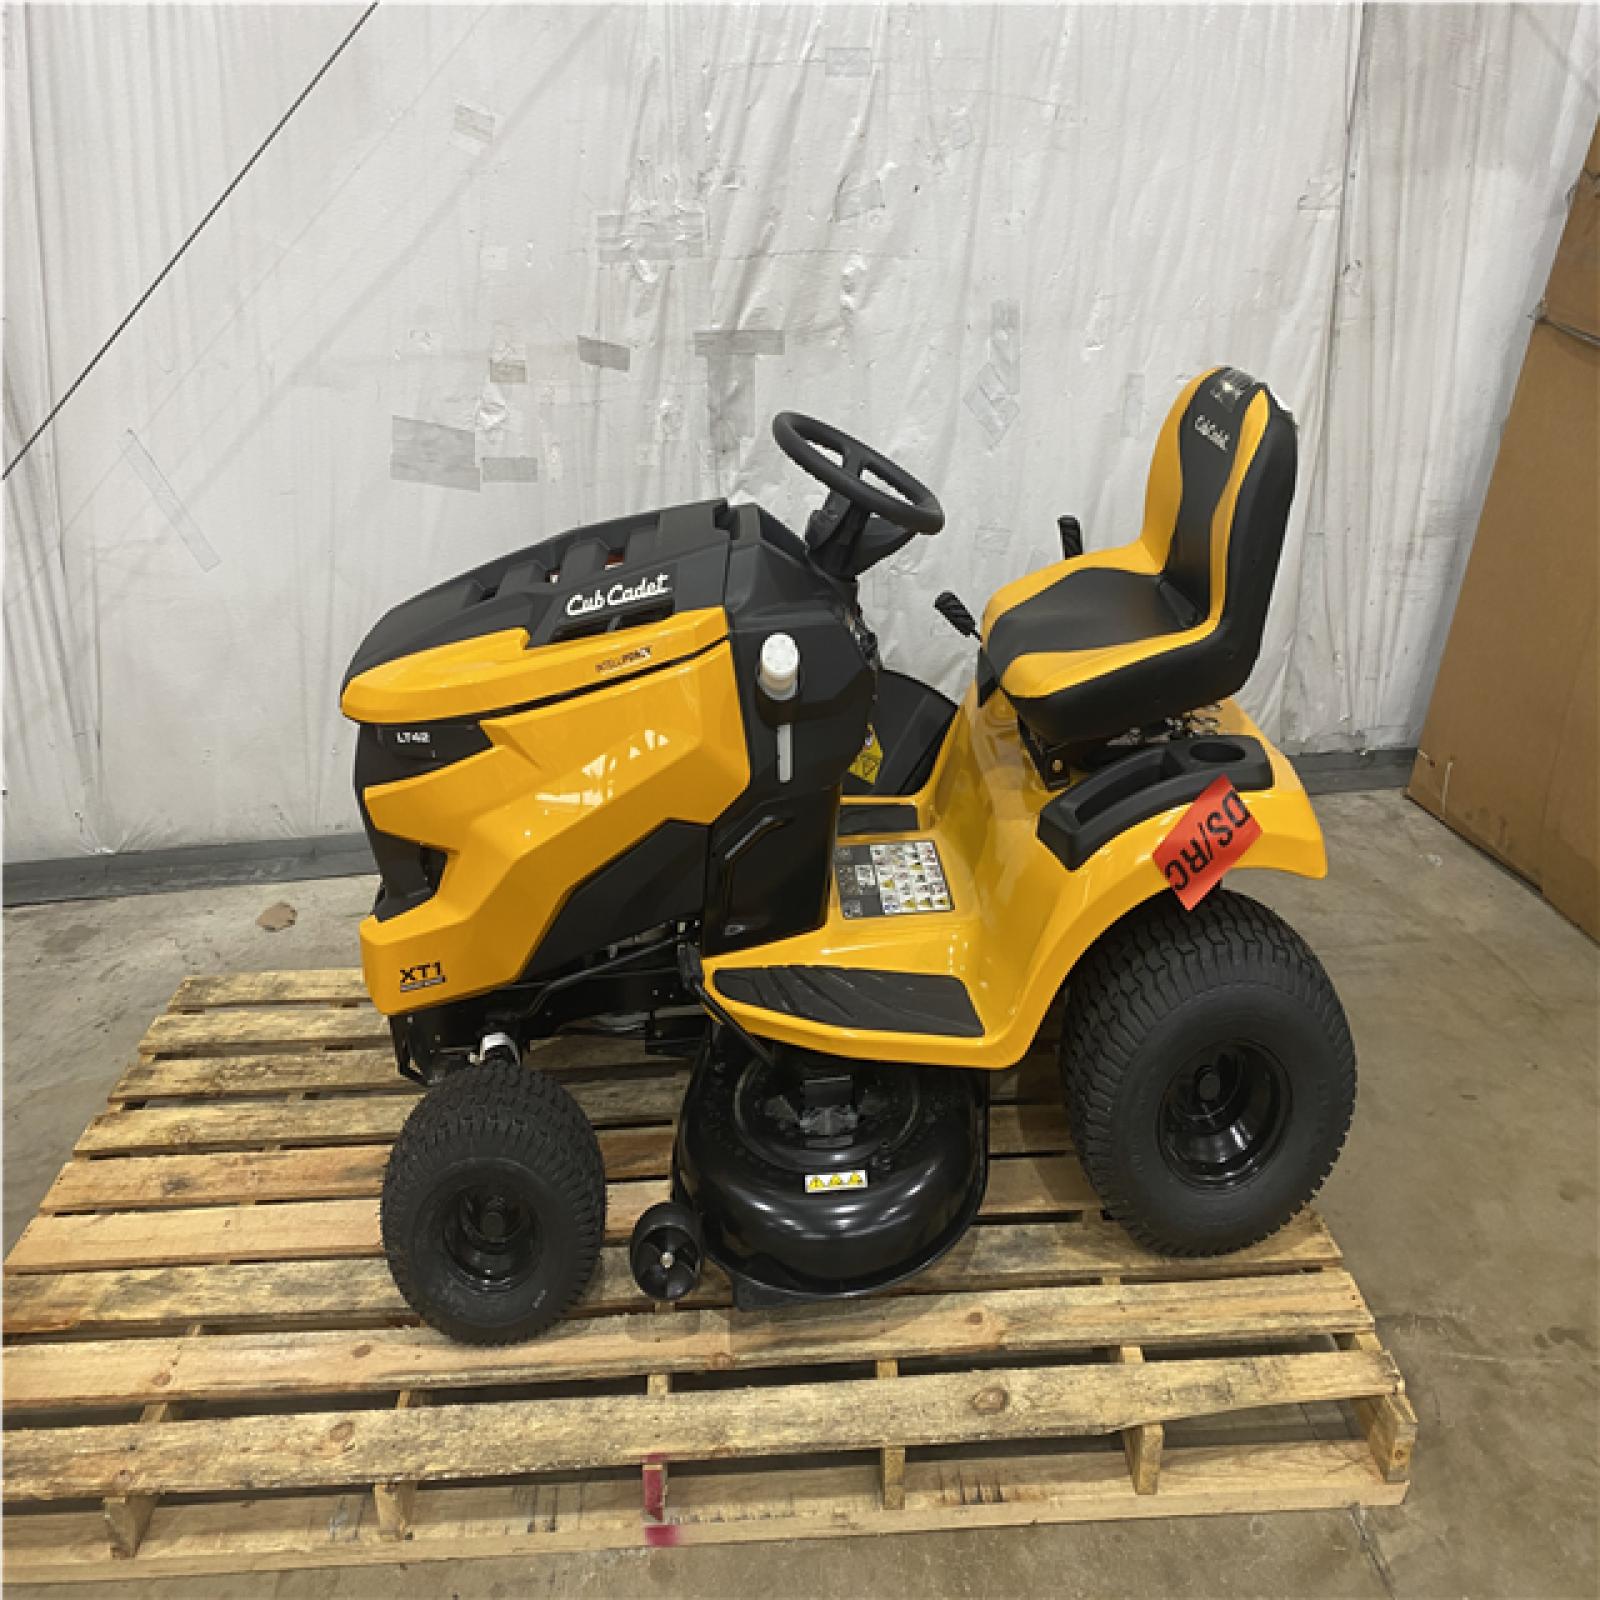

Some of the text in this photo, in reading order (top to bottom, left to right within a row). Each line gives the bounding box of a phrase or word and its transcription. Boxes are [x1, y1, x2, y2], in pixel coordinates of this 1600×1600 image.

[566, 573, 672, 615] Cub Cadet
[400, 961, 440, 983] XT1
